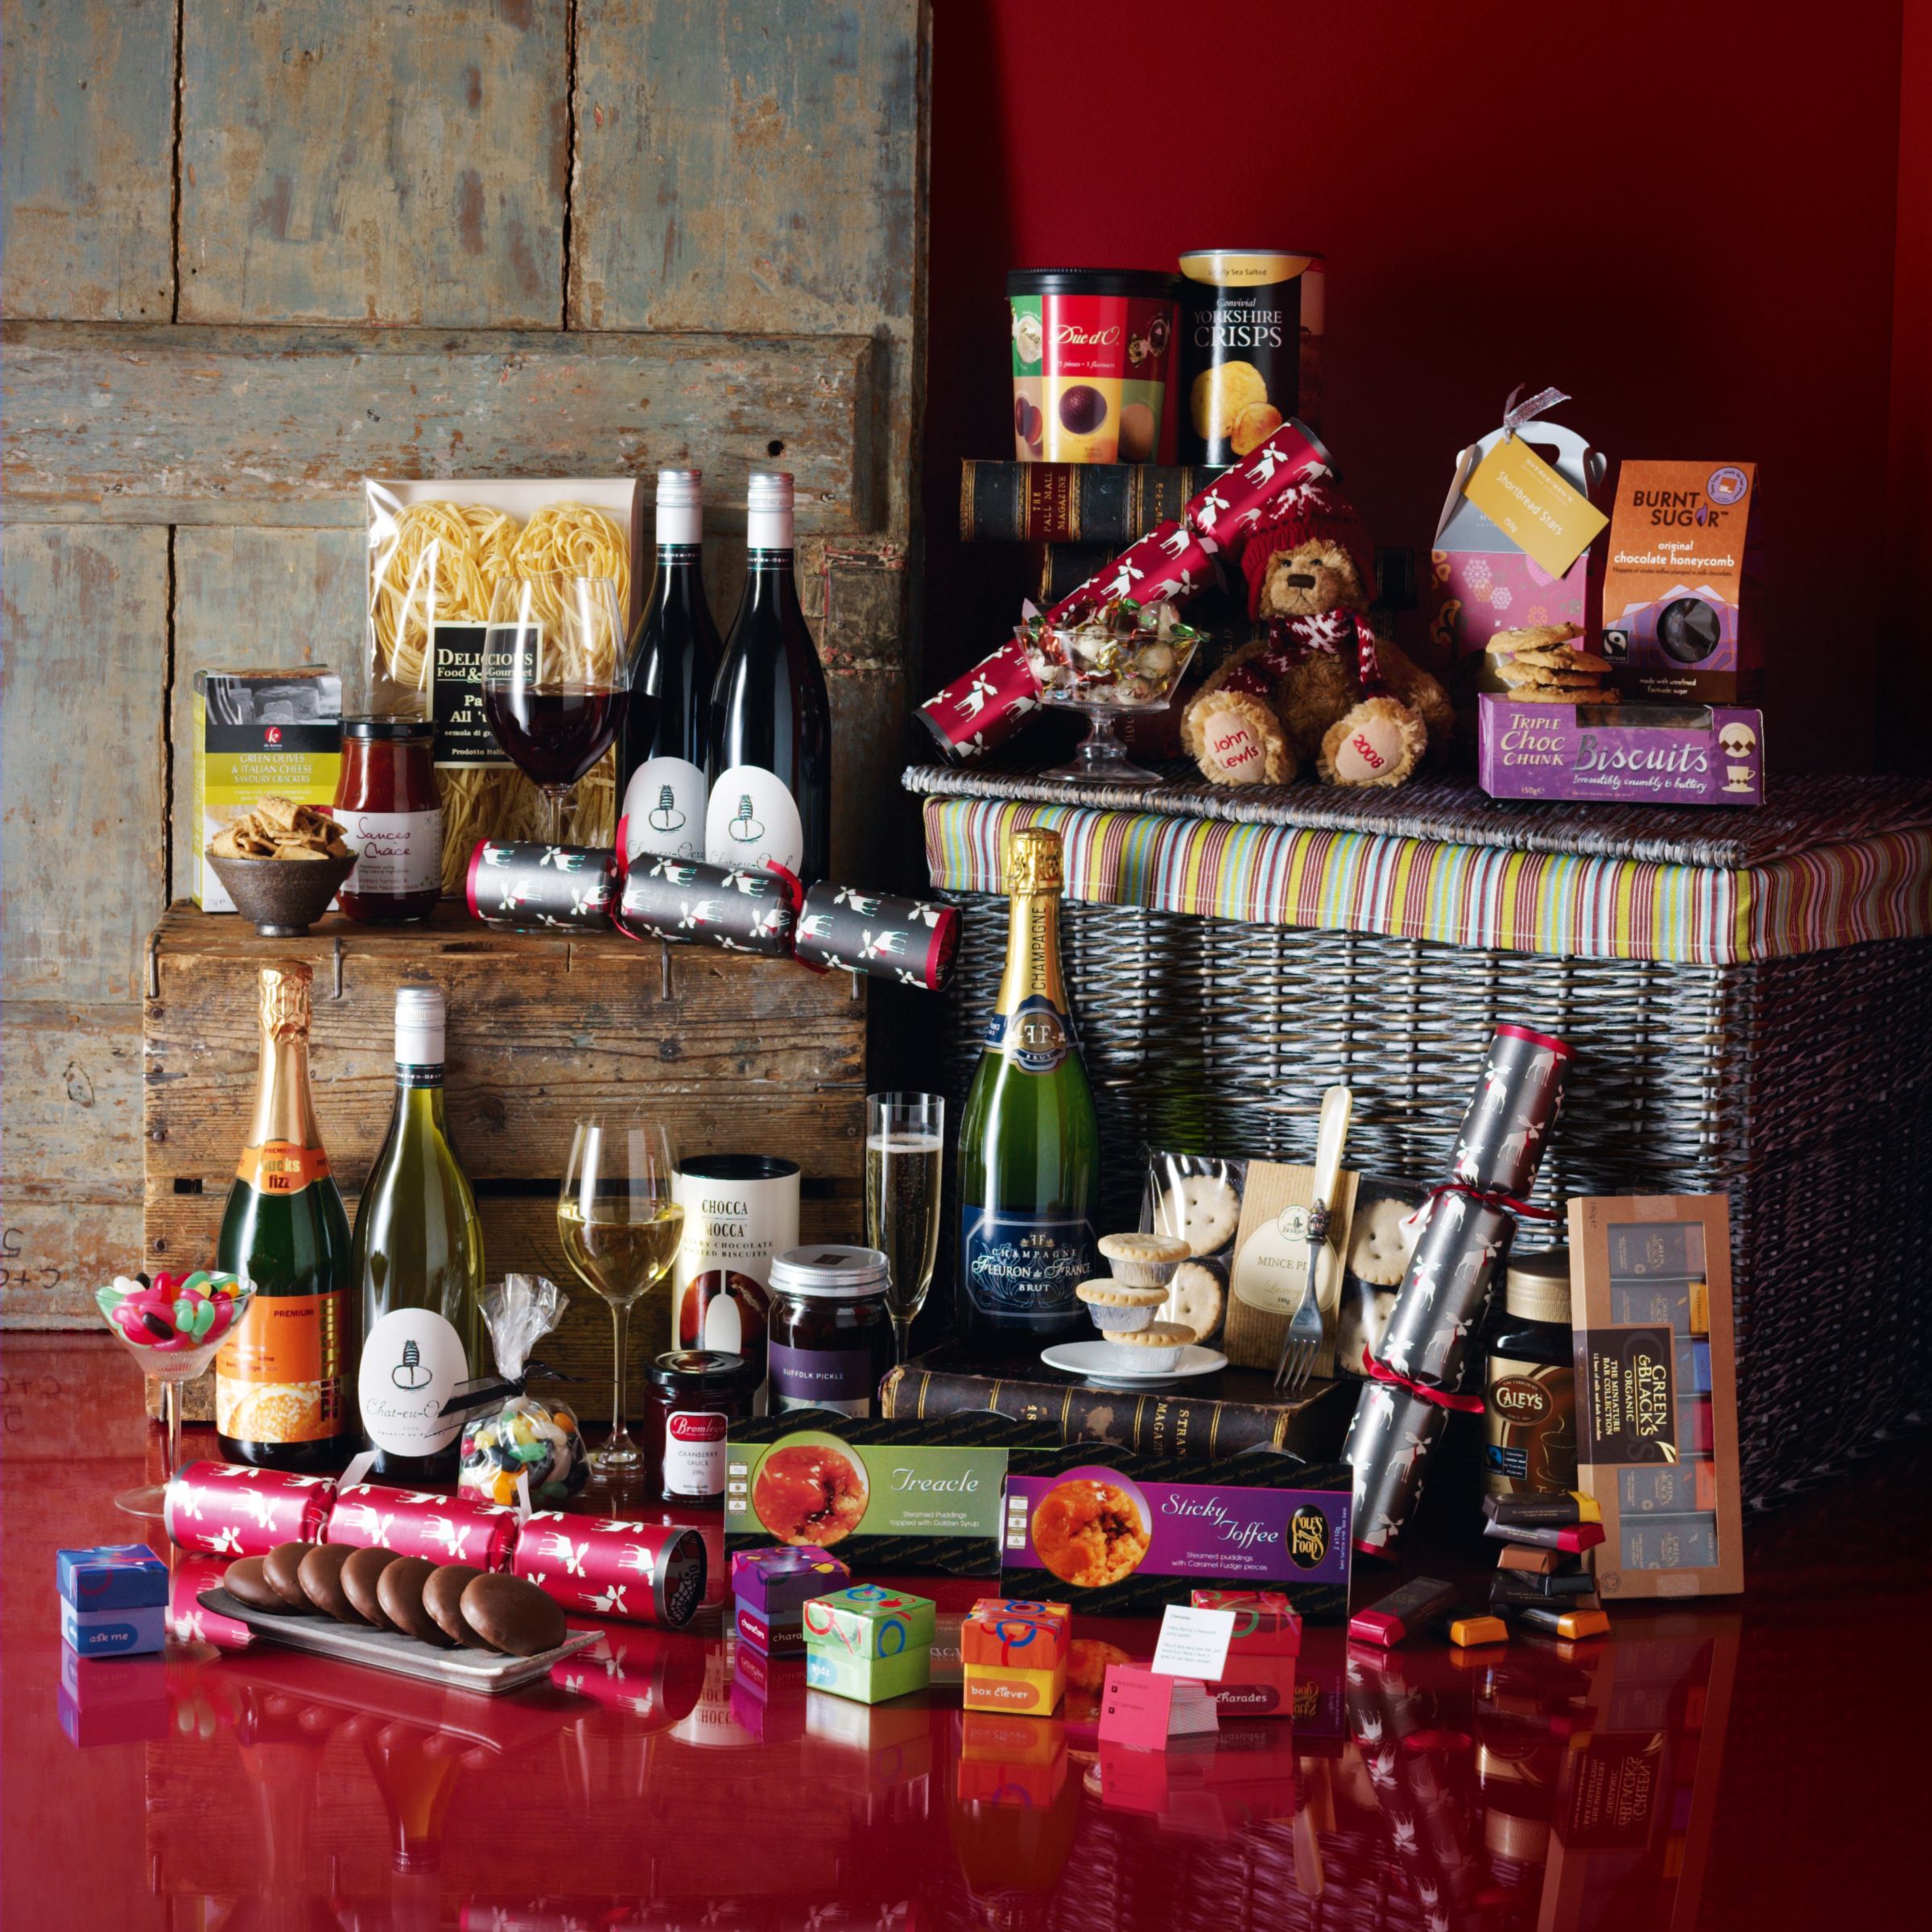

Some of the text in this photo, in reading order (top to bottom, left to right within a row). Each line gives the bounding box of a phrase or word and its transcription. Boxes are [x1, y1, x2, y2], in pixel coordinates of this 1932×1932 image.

[1216, 298, 1257, 307] Convivial
[1194, 310, 1282, 323] YORKSHIRE
[1194, 326, 1282, 348] CRISPS
[1044, 471, 1052, 500] MALL
[1496, 471, 1542, 515] Shortbread
[1033, 491, 1041, 511] THE
[1057, 476, 1066, 530] MAGAZINE
[1633, 490, 1700, 508] BURNT
[1539, 511, 1563, 535] Stars
[1658, 540, 1694, 552] original
[1614, 551, 1735, 568] chocolate honeycomb
[437, 667, 465, 677] Food
[466, 667, 481, 683] &
[450, 711, 471, 722] All
[1214, 730, 1249, 753] John
[1501, 730, 1566, 751] Choc
[240, 753, 305, 763] GREEN OLIVES
[1219, 744, 1260, 769] Lewis
[1352, 734, 1384, 769] 2008
[1571, 734, 1707, 773] Biscuits
[232, 765, 312, 774] & ITALIAN CHEESE
[1624, 777, 1662, 791] crumbly
[1674, 778, 1707, 794] buttery
[357, 816, 411, 840] Sauces
[1030, 906, 1046, 991] CHAMPAGNE
[269, 1174, 290, 1188] fizz
[702, 1199, 748, 1215] CHOCCA
[715, 1241, 773, 1249] CHOCOLATE
[992, 1249, 1077, 1258] CHAMPAGNE
[722, 1250, 767, 1258] BISCUITS
[1257, 1256, 1294, 1269] MINCE
[972, 1255, 1091, 1278] FLEURON de FRANCE
[274, 1309, 314, 1318] PREMIUM
[783, 1368, 813, 1379] SUFFOLK
[1496, 1387, 1543, 1410] CALEY'S
[1624, 1370, 1634, 1422] ORGANIC
[1652, 1364, 1667, 1425] GREEN
[1604, 1378, 1612, 1435] COLLECTION
[1612, 1381, 1620, 1432] MINIATURE
[1176, 1409, 1189, 1455] STRAN
[890, 1468, 979, 1492] Treacle
[935, 1511, 966, 1519] Puddings
[1162, 1493, 1228, 1525] Sticky
[1218, 1520, 1278, 1549] Toffee
[1187, 1551, 1253, 1562] Steamed puddings
[1188, 1560, 1218, 1568] Caramel
[1220, 1562, 1242, 1570] Fudge
[89, 1633, 129, 1643] ask me
[811, 1663, 830, 1677] kidz
[971, 1685, 1028, 1699] box clever
[1216, 1691, 1267, 1703] charades
